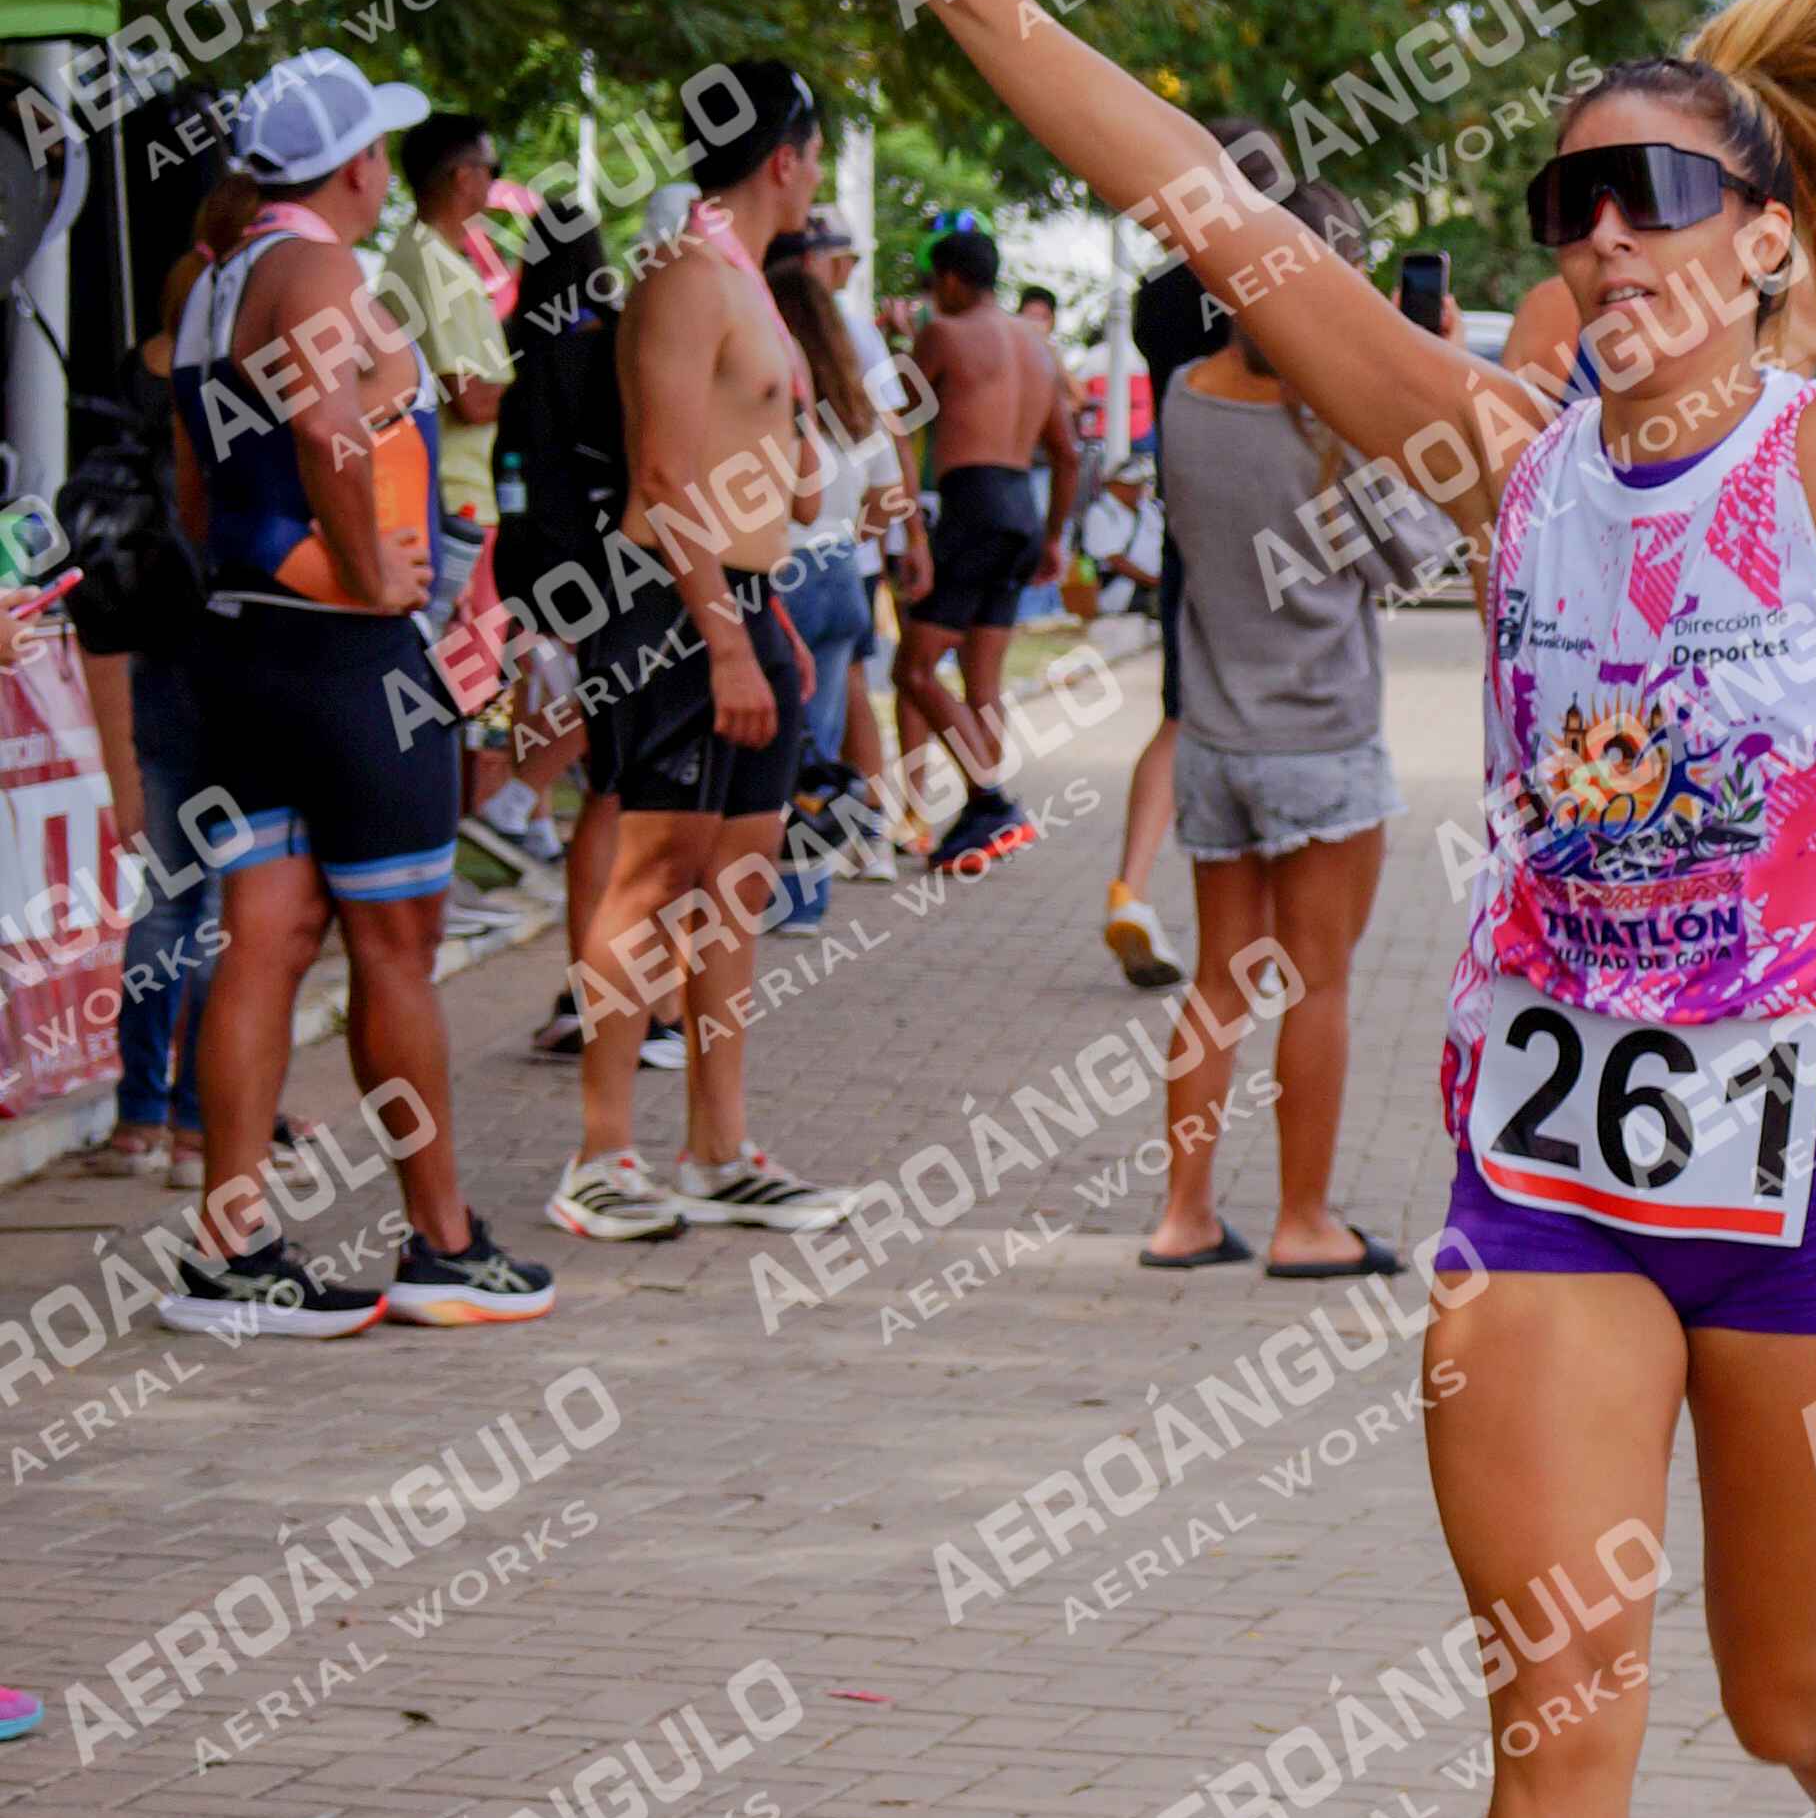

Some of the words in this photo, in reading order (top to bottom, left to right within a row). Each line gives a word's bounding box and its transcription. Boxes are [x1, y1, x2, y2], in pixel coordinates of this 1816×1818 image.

[1674, 612, 1761, 637] Dirección
[1672, 639, 1790, 670] Deportes
[1541, 904, 1738, 950] TRIATLÓN
[1637, 954, 1669, 971] DE
[1491, 1006, 1800, 1198] 261
